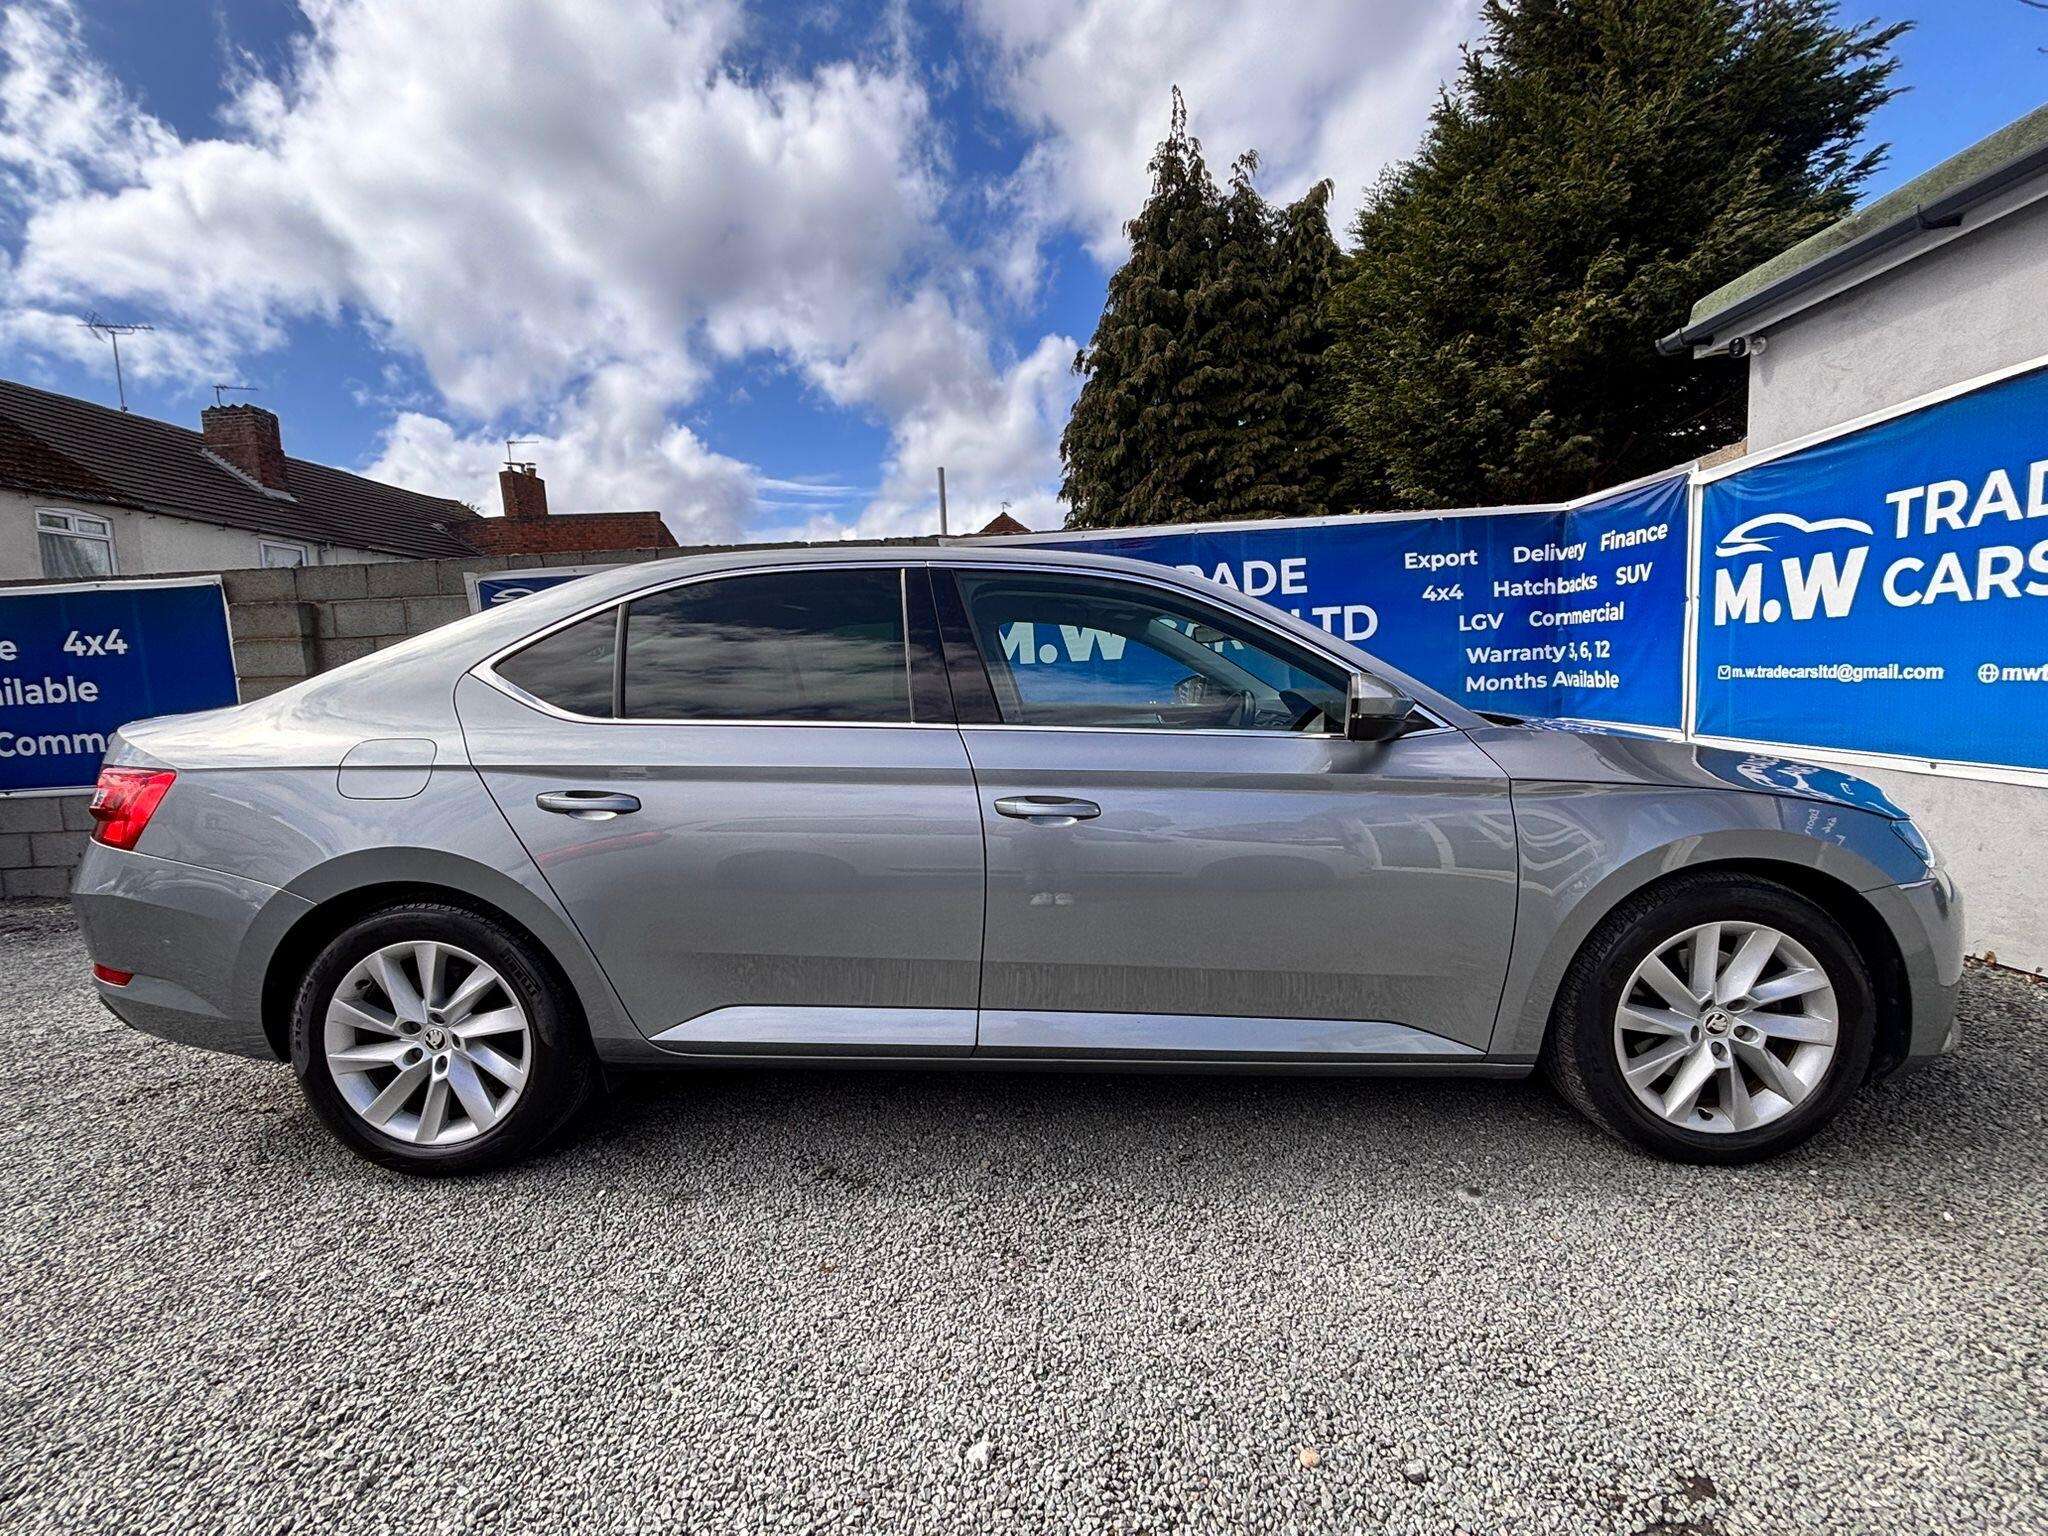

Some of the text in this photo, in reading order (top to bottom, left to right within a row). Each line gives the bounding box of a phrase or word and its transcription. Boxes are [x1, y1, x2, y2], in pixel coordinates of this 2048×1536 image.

[1405, 523, 1668, 571] Export Delivery Finance
[1176, 558, 1308, 597] ADE
[1422, 562, 1653, 602] 4x4 Hatchbacks SUV
[1714, 546, 1869, 625] M.W
[1883, 538, 2048, 607] CARS
[1291, 604, 1379, 642] TD
[1459, 602, 1624, 632] LGV Commercial
[63, 629, 128, 656] 4x4
[1465, 645, 1566, 663] Warranty
[1594, 640, 1611, 658] 12
[0, 676, 98, 706] ilable
[1466, 669, 1620, 692] Months Available
[0, 731, 114, 757] Comm
